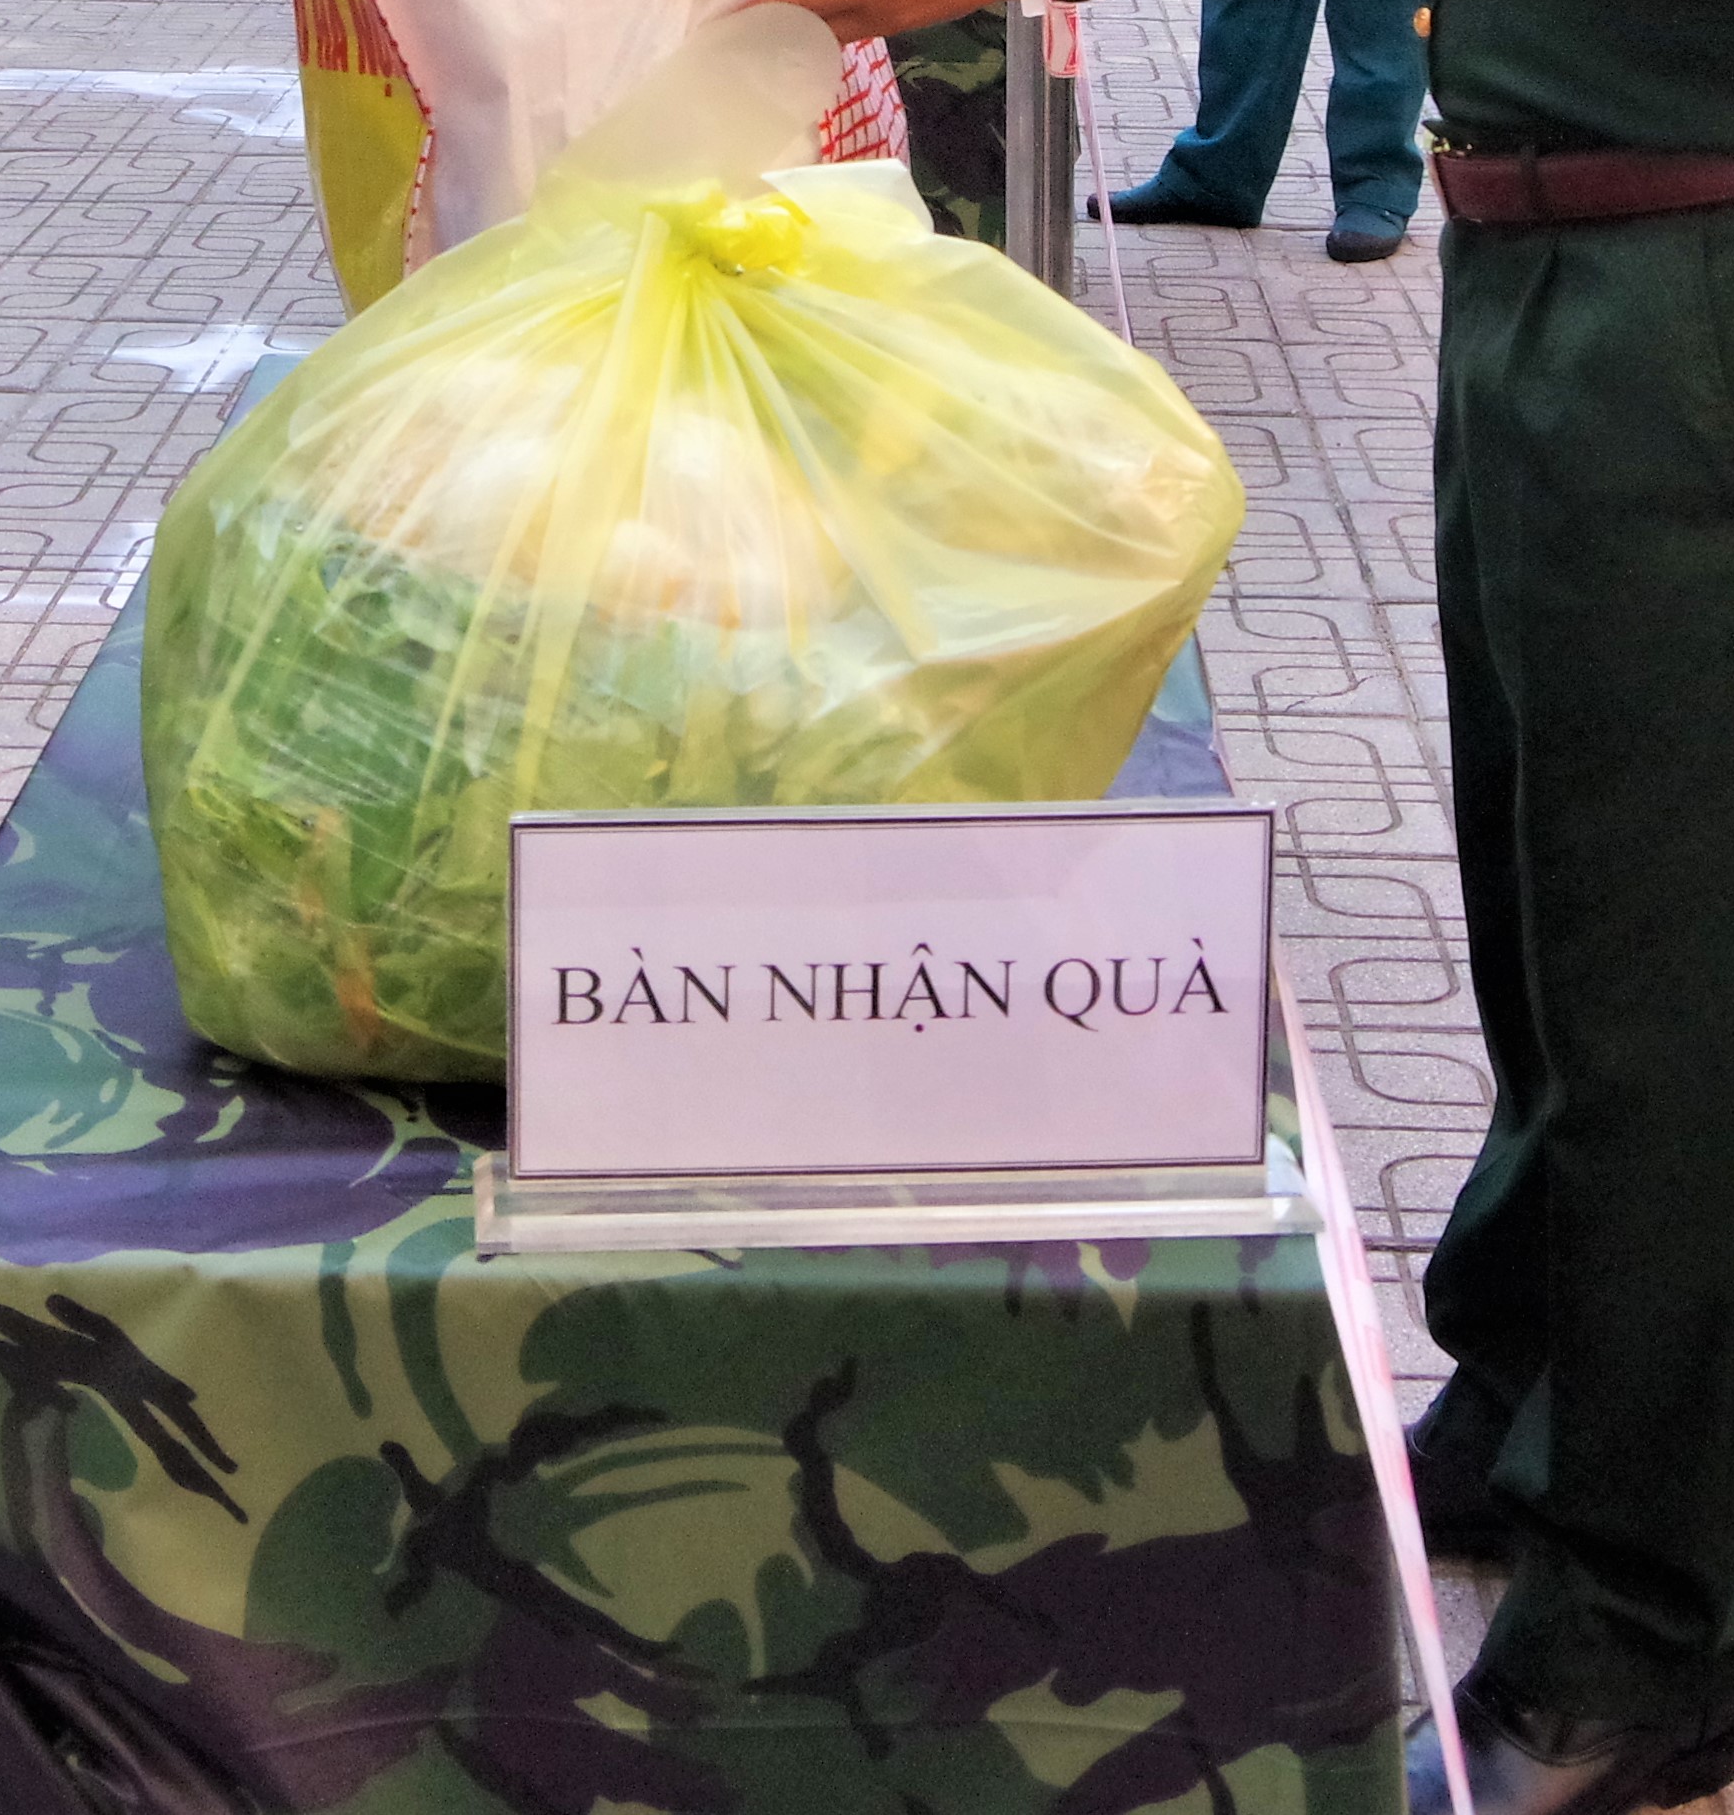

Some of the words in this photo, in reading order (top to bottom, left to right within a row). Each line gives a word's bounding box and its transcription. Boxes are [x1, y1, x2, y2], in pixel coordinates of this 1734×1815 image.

[552, 946, 738, 1026] BÀN
[759, 942, 1017, 1034] NHẬN
[1043, 937, 1229, 1033] QUÀ
